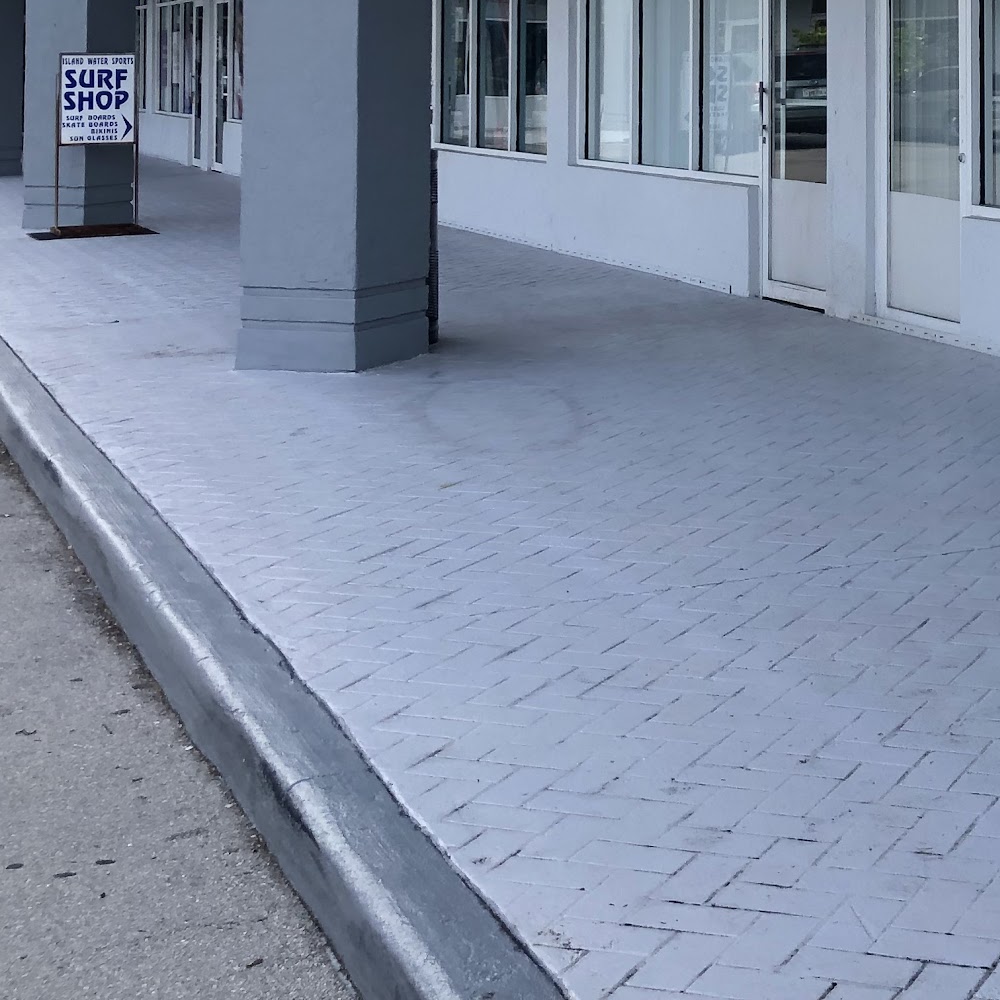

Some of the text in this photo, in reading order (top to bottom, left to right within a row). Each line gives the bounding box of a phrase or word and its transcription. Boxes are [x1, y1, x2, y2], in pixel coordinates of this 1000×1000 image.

[62, 57, 134, 66] ISLAND WATER SPORTS
[64, 69, 128, 90] SURF
[63, 90, 129, 113] SHOP
